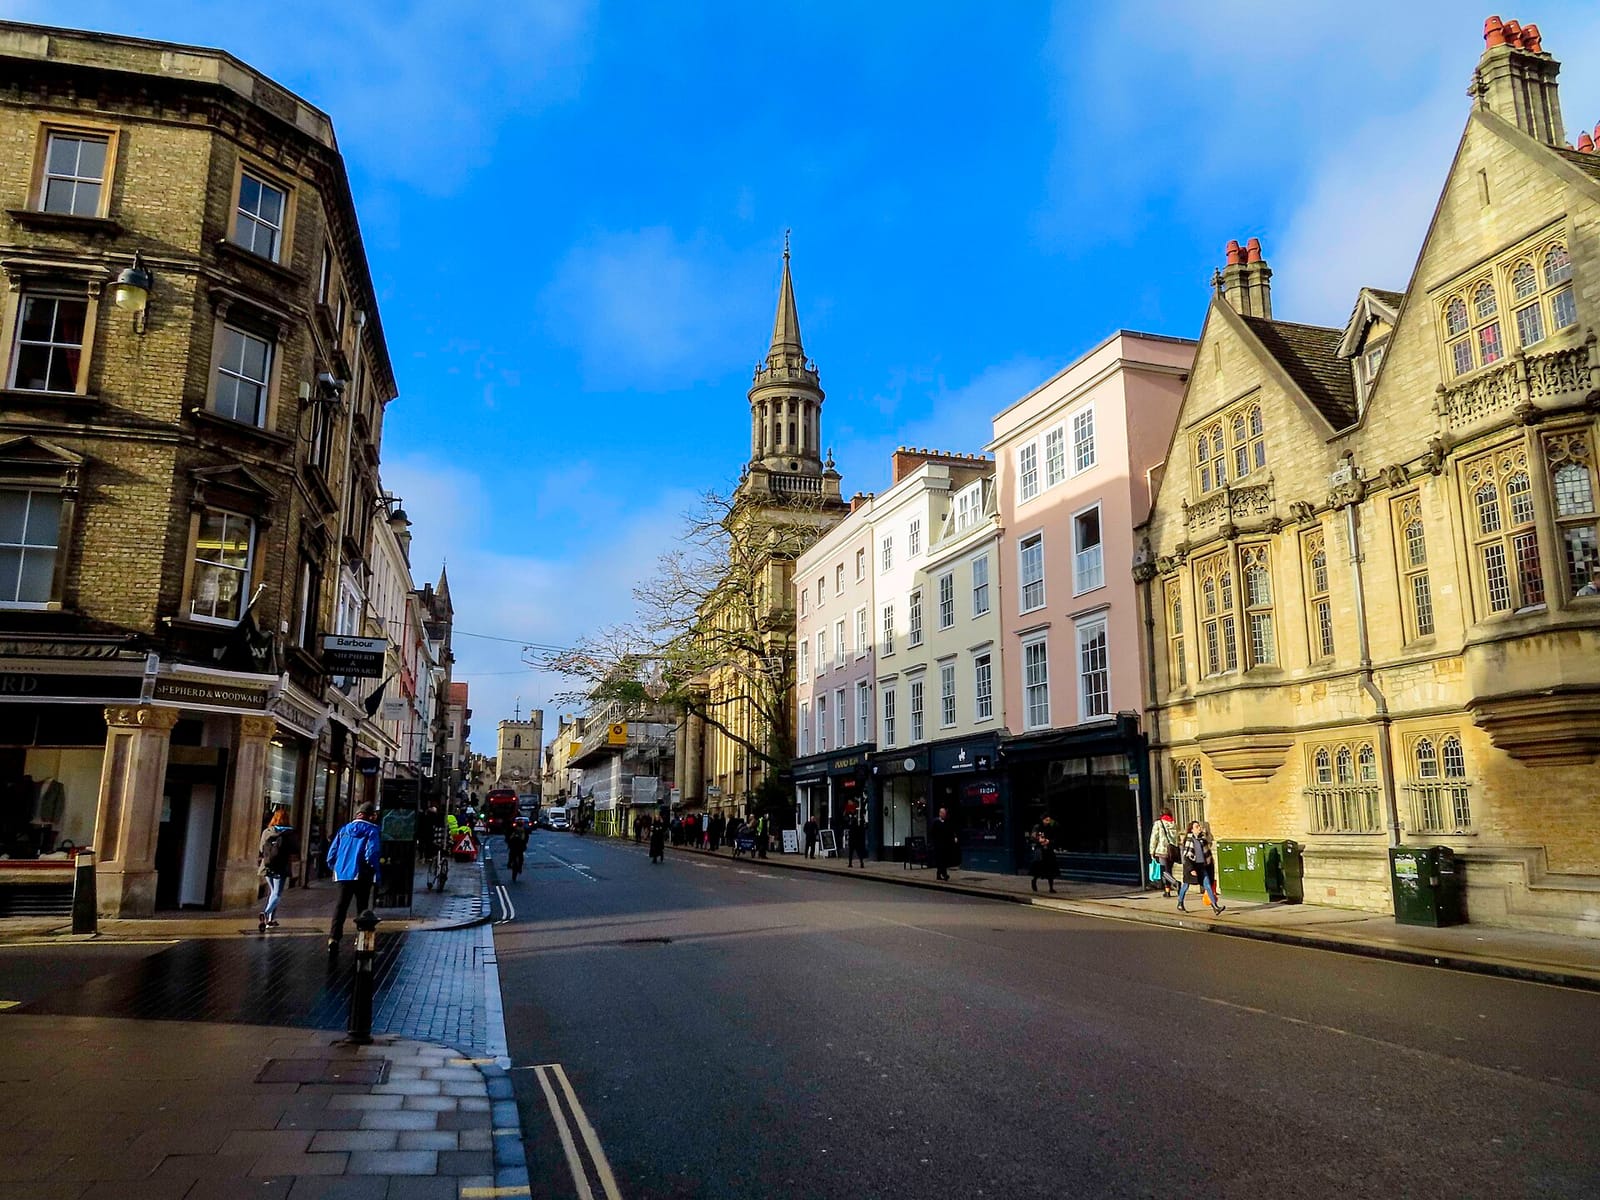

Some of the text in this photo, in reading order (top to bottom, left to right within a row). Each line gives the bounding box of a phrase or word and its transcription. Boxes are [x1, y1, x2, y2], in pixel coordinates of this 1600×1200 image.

[337, 638, 374, 648] Barbour
[156, 684, 265, 704] SHEPHERD & WOODWARD
